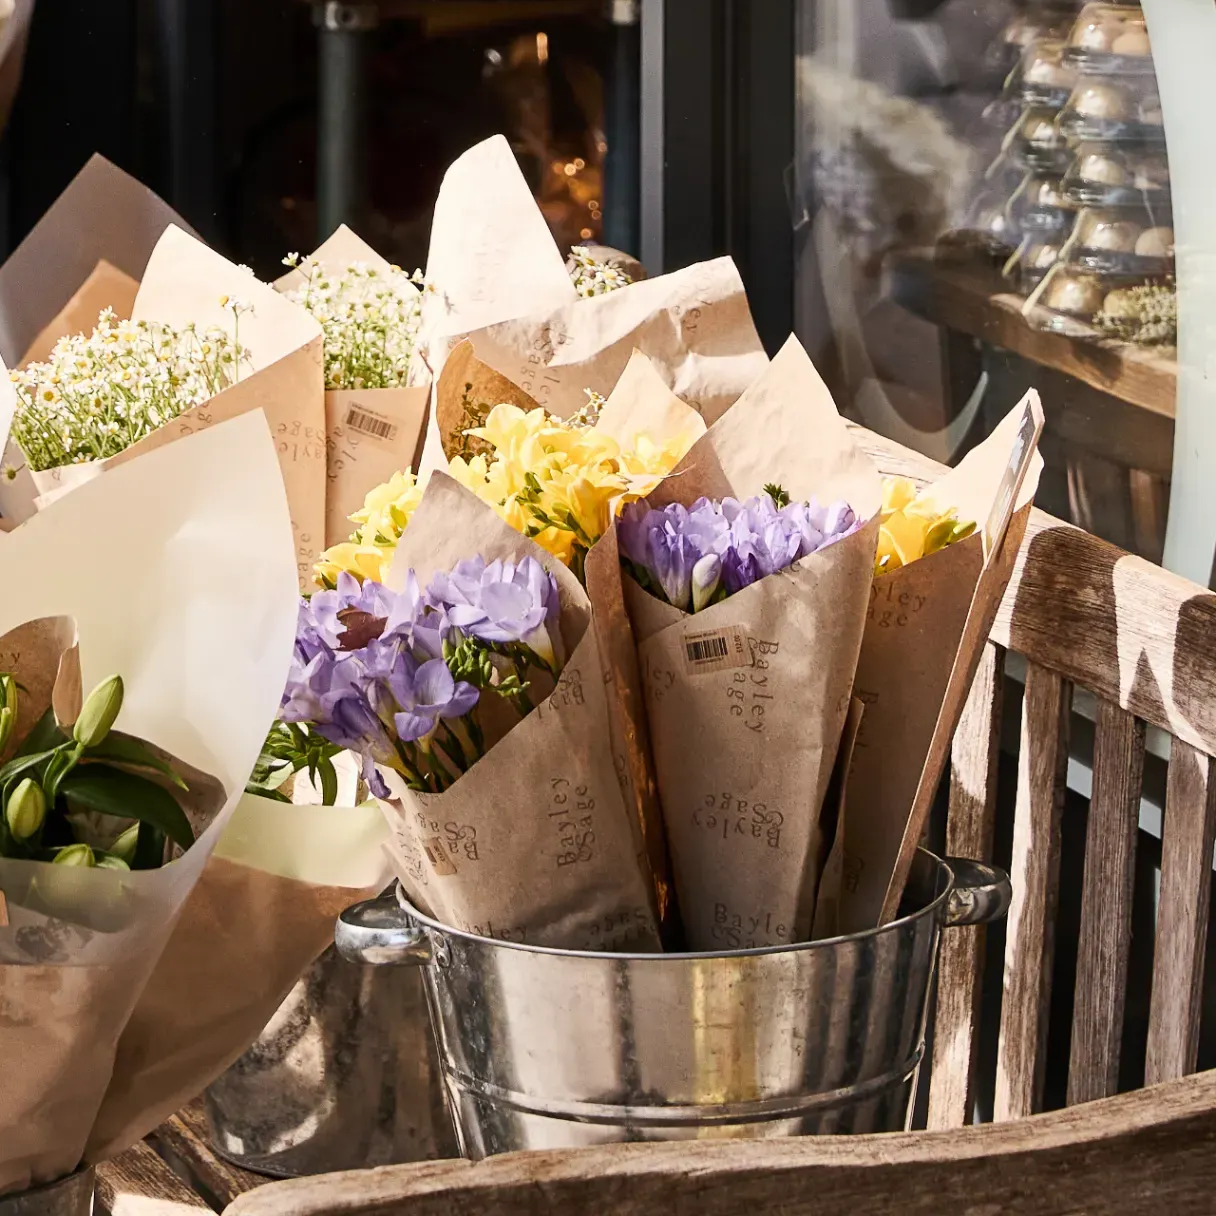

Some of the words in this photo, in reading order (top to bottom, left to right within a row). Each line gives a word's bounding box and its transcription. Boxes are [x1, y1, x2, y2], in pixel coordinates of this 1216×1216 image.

[745, 639, 780, 734] Bayley
[548, 777, 577, 868] Bayley
[691, 808, 781, 849] Bayley
